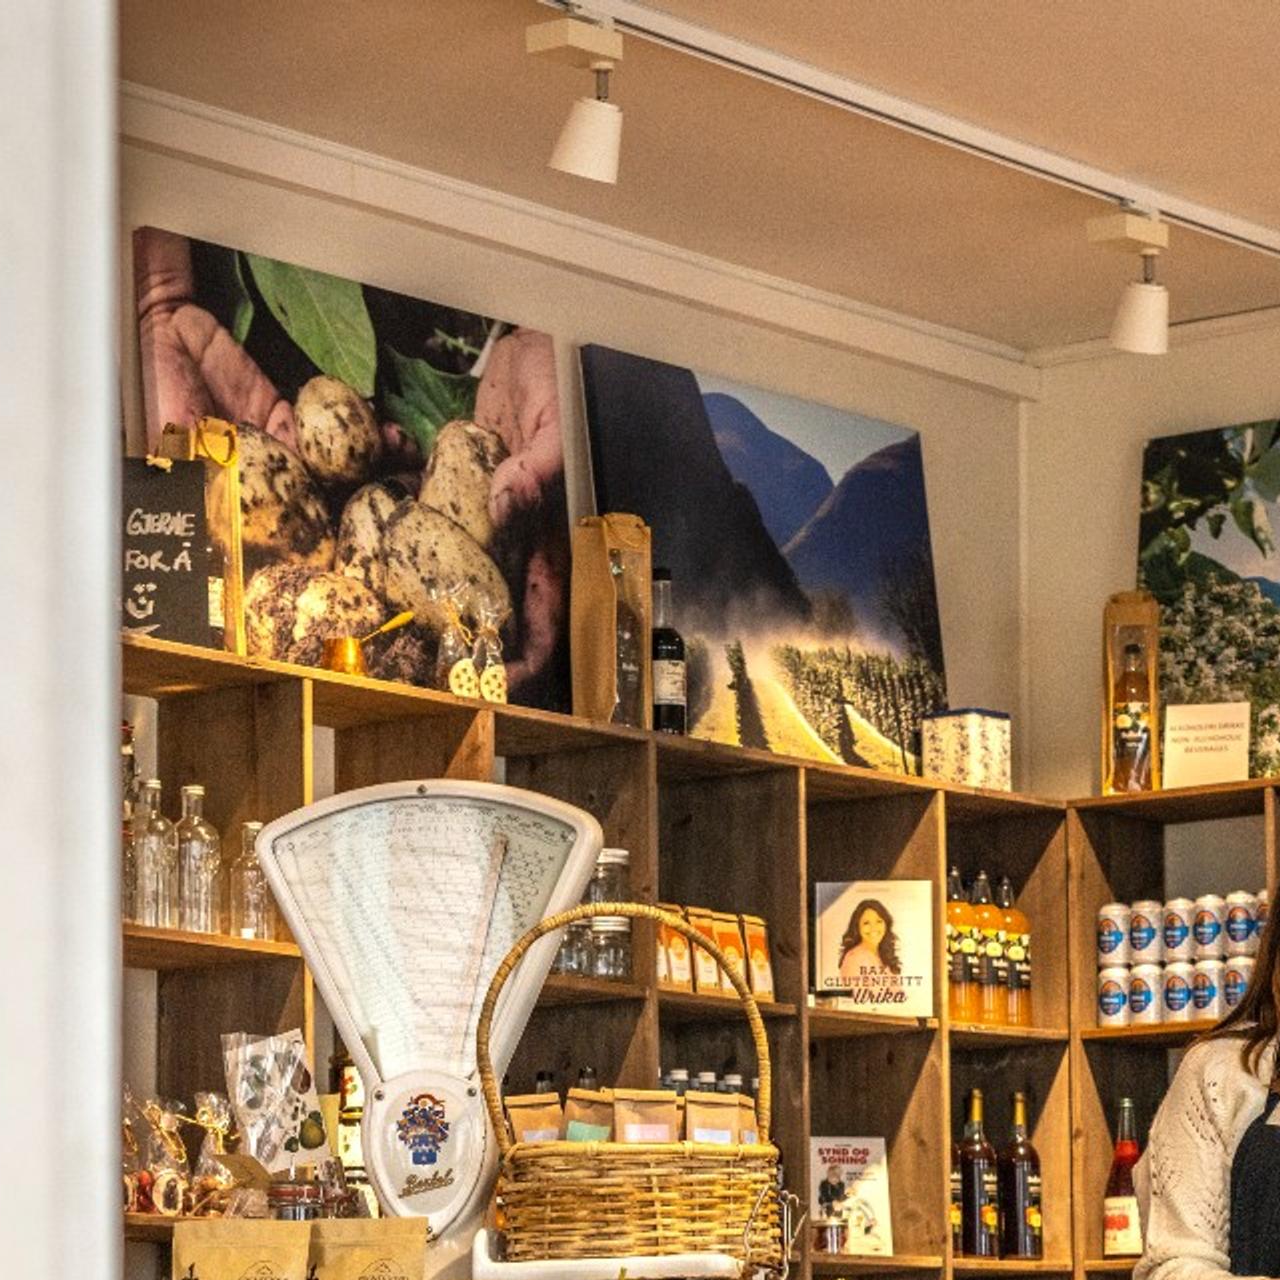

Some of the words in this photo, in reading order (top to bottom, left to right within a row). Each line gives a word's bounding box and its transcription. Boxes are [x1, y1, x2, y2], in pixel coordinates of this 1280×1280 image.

[126, 508, 195, 536] GJERNE
[823, 976, 923, 987] GLUTENFRITT
[818, 1147, 849, 1156] SYND
[852, 1148, 869, 1156] OG
